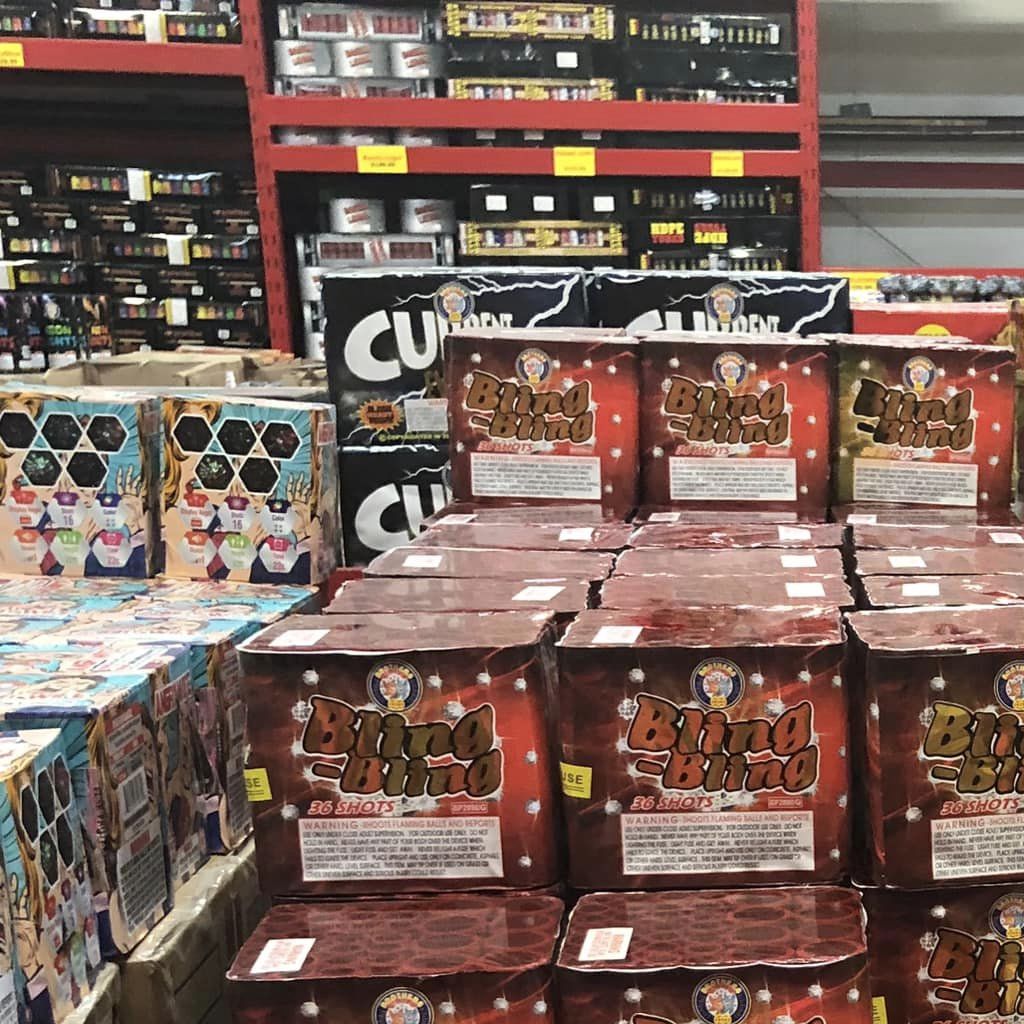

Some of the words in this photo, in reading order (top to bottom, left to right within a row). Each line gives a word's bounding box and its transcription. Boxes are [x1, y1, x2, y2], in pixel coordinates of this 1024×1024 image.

[465, 370, 591, 417] Bling
[664, 375, 787, 419] Bling
[853, 377, 974, 422] Bling
[302, 694, 497, 760] Bling
[627, 693, 812, 757] Bling
[307, 801, 338, 816] 36
[339, 800, 396, 815] SHOTS
[631, 796, 660, 812] 36
[663, 796, 714, 811] SHOTS
[940, 800, 961, 816] 36
[963, 797, 1020, 814] SHOTS
